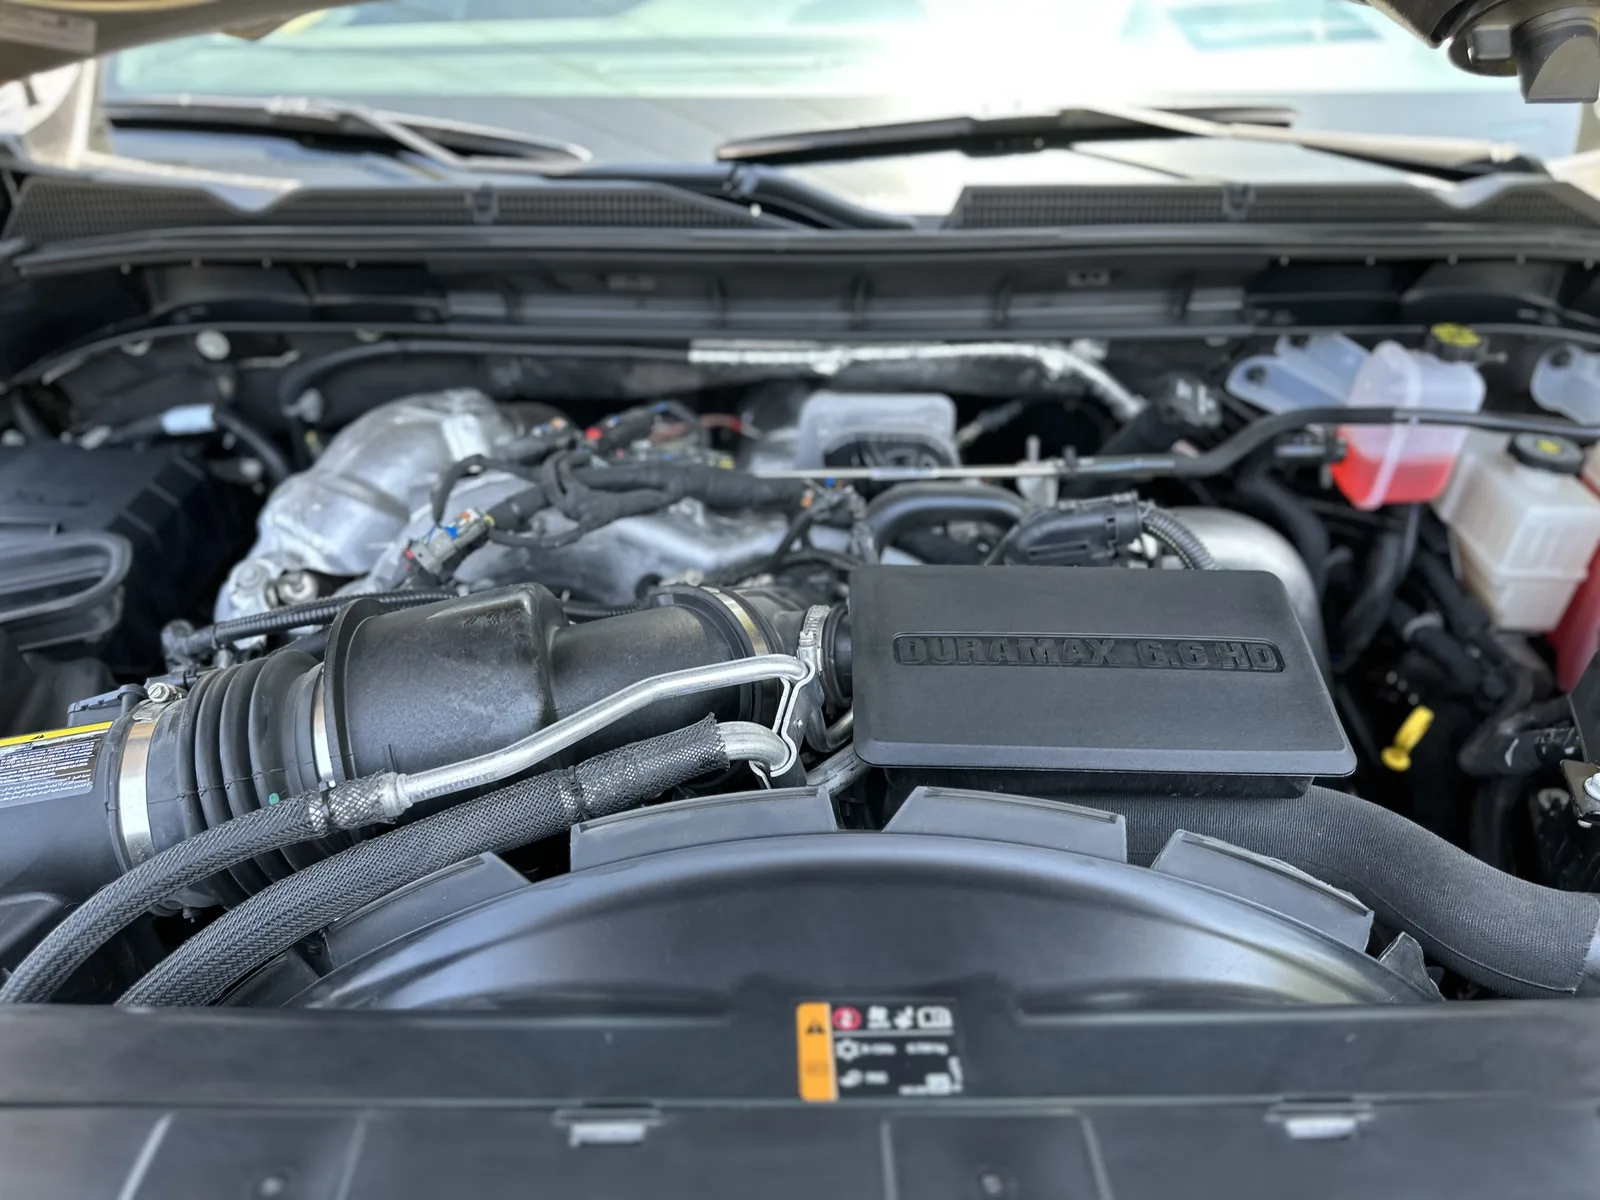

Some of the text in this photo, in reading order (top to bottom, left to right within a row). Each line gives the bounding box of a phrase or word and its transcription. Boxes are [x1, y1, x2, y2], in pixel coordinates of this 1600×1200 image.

[900, 637, 1278, 670] DURAMAX 6.6 HD
